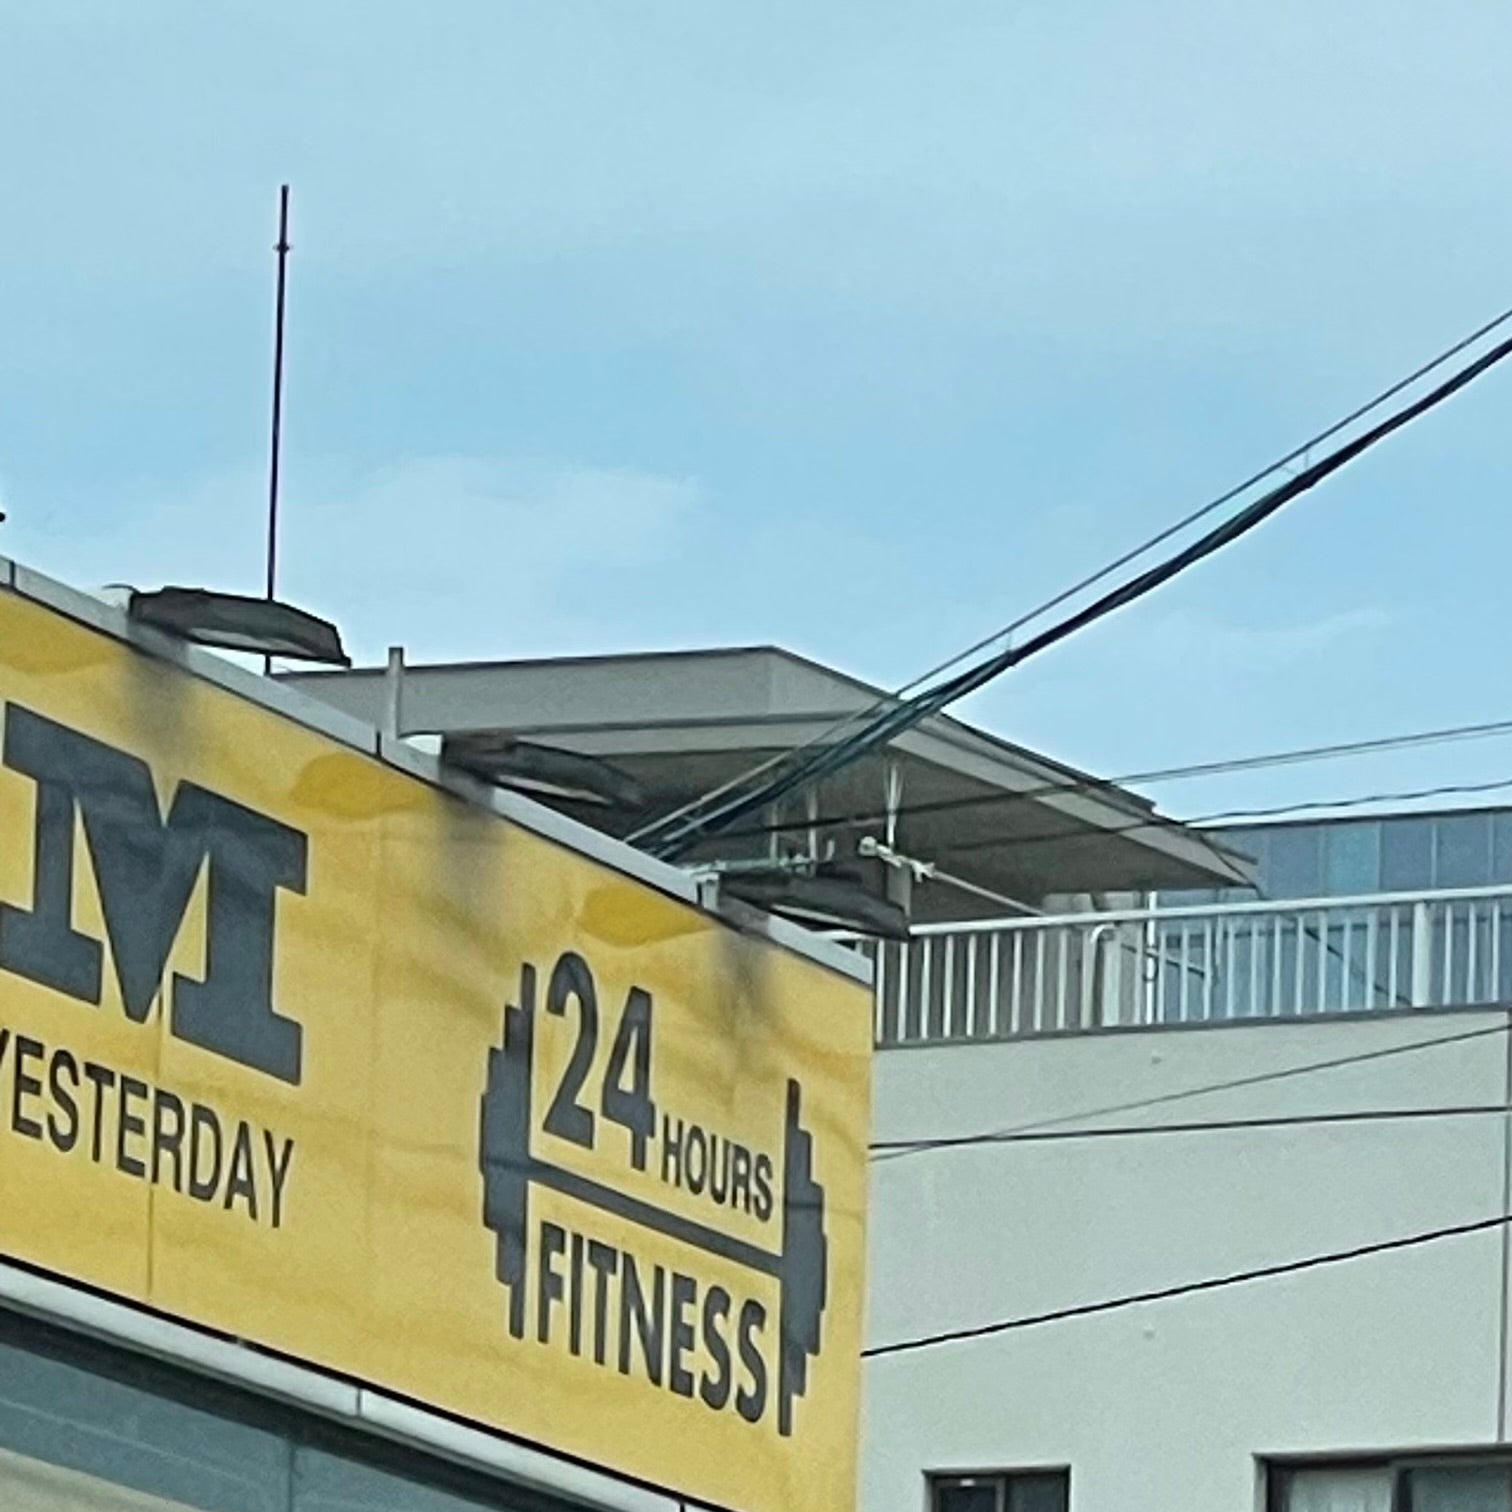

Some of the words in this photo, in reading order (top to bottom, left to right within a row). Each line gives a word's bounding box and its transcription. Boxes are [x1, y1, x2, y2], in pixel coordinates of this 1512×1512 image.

[0, 700, 308, 1087] M
[544, 952, 656, 1170] 24
[661, 1116, 774, 1222] HOURS
[538, 1221, 767, 1422] FITNESS
